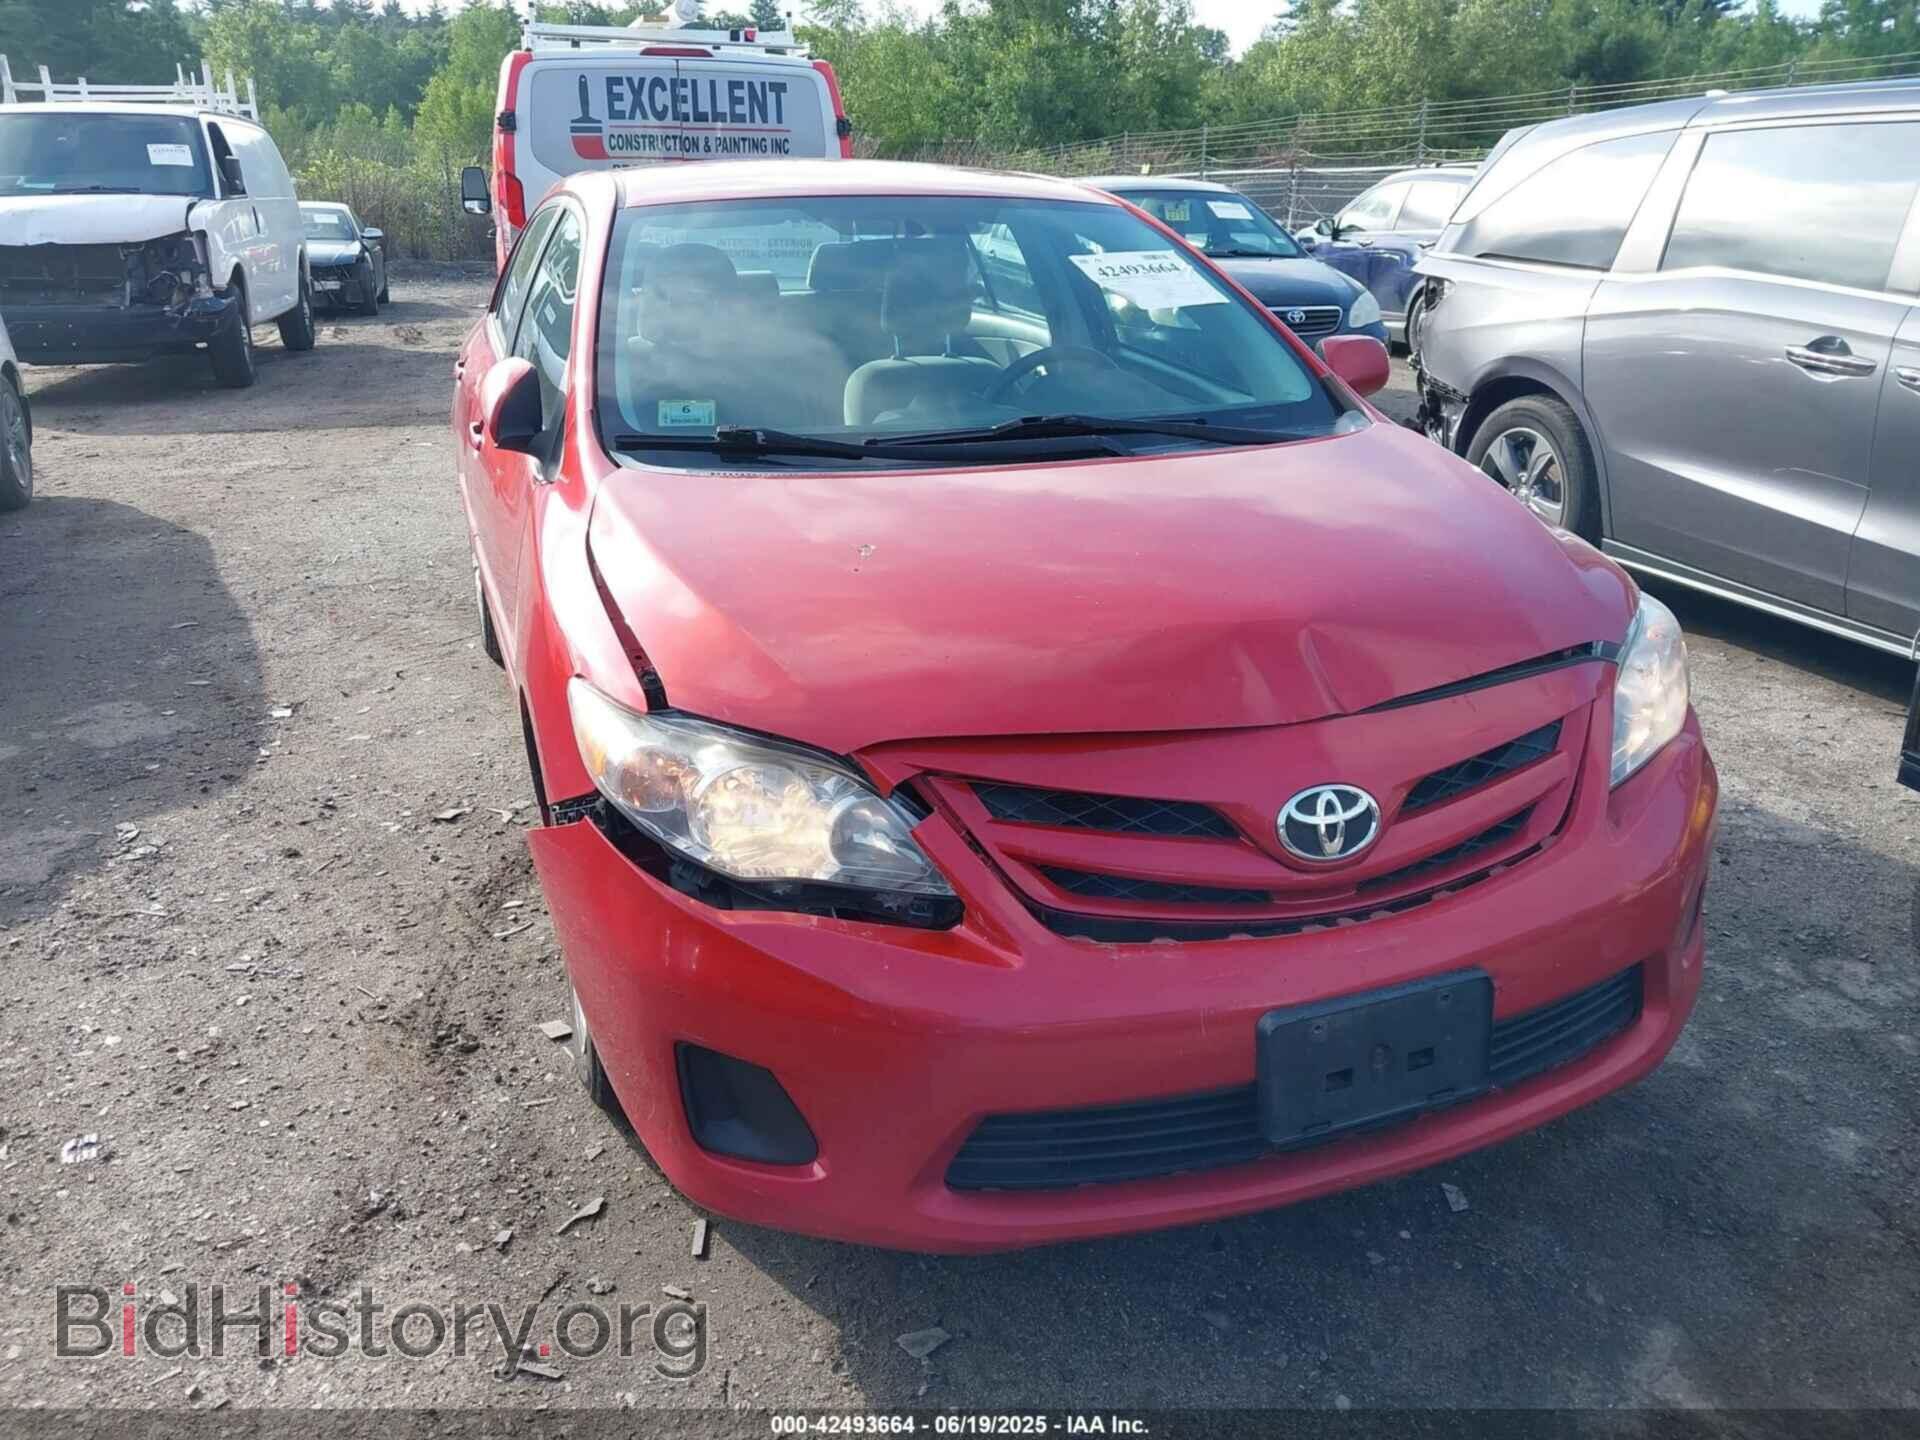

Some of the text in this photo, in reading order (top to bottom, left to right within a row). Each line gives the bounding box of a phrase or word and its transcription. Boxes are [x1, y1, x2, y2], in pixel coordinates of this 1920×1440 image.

[605, 76, 787, 124] EXCELLENT
[608, 134, 790, 155] CONSTRUCTION & PAINTING INC
[682, 405, 691, 414] 6
